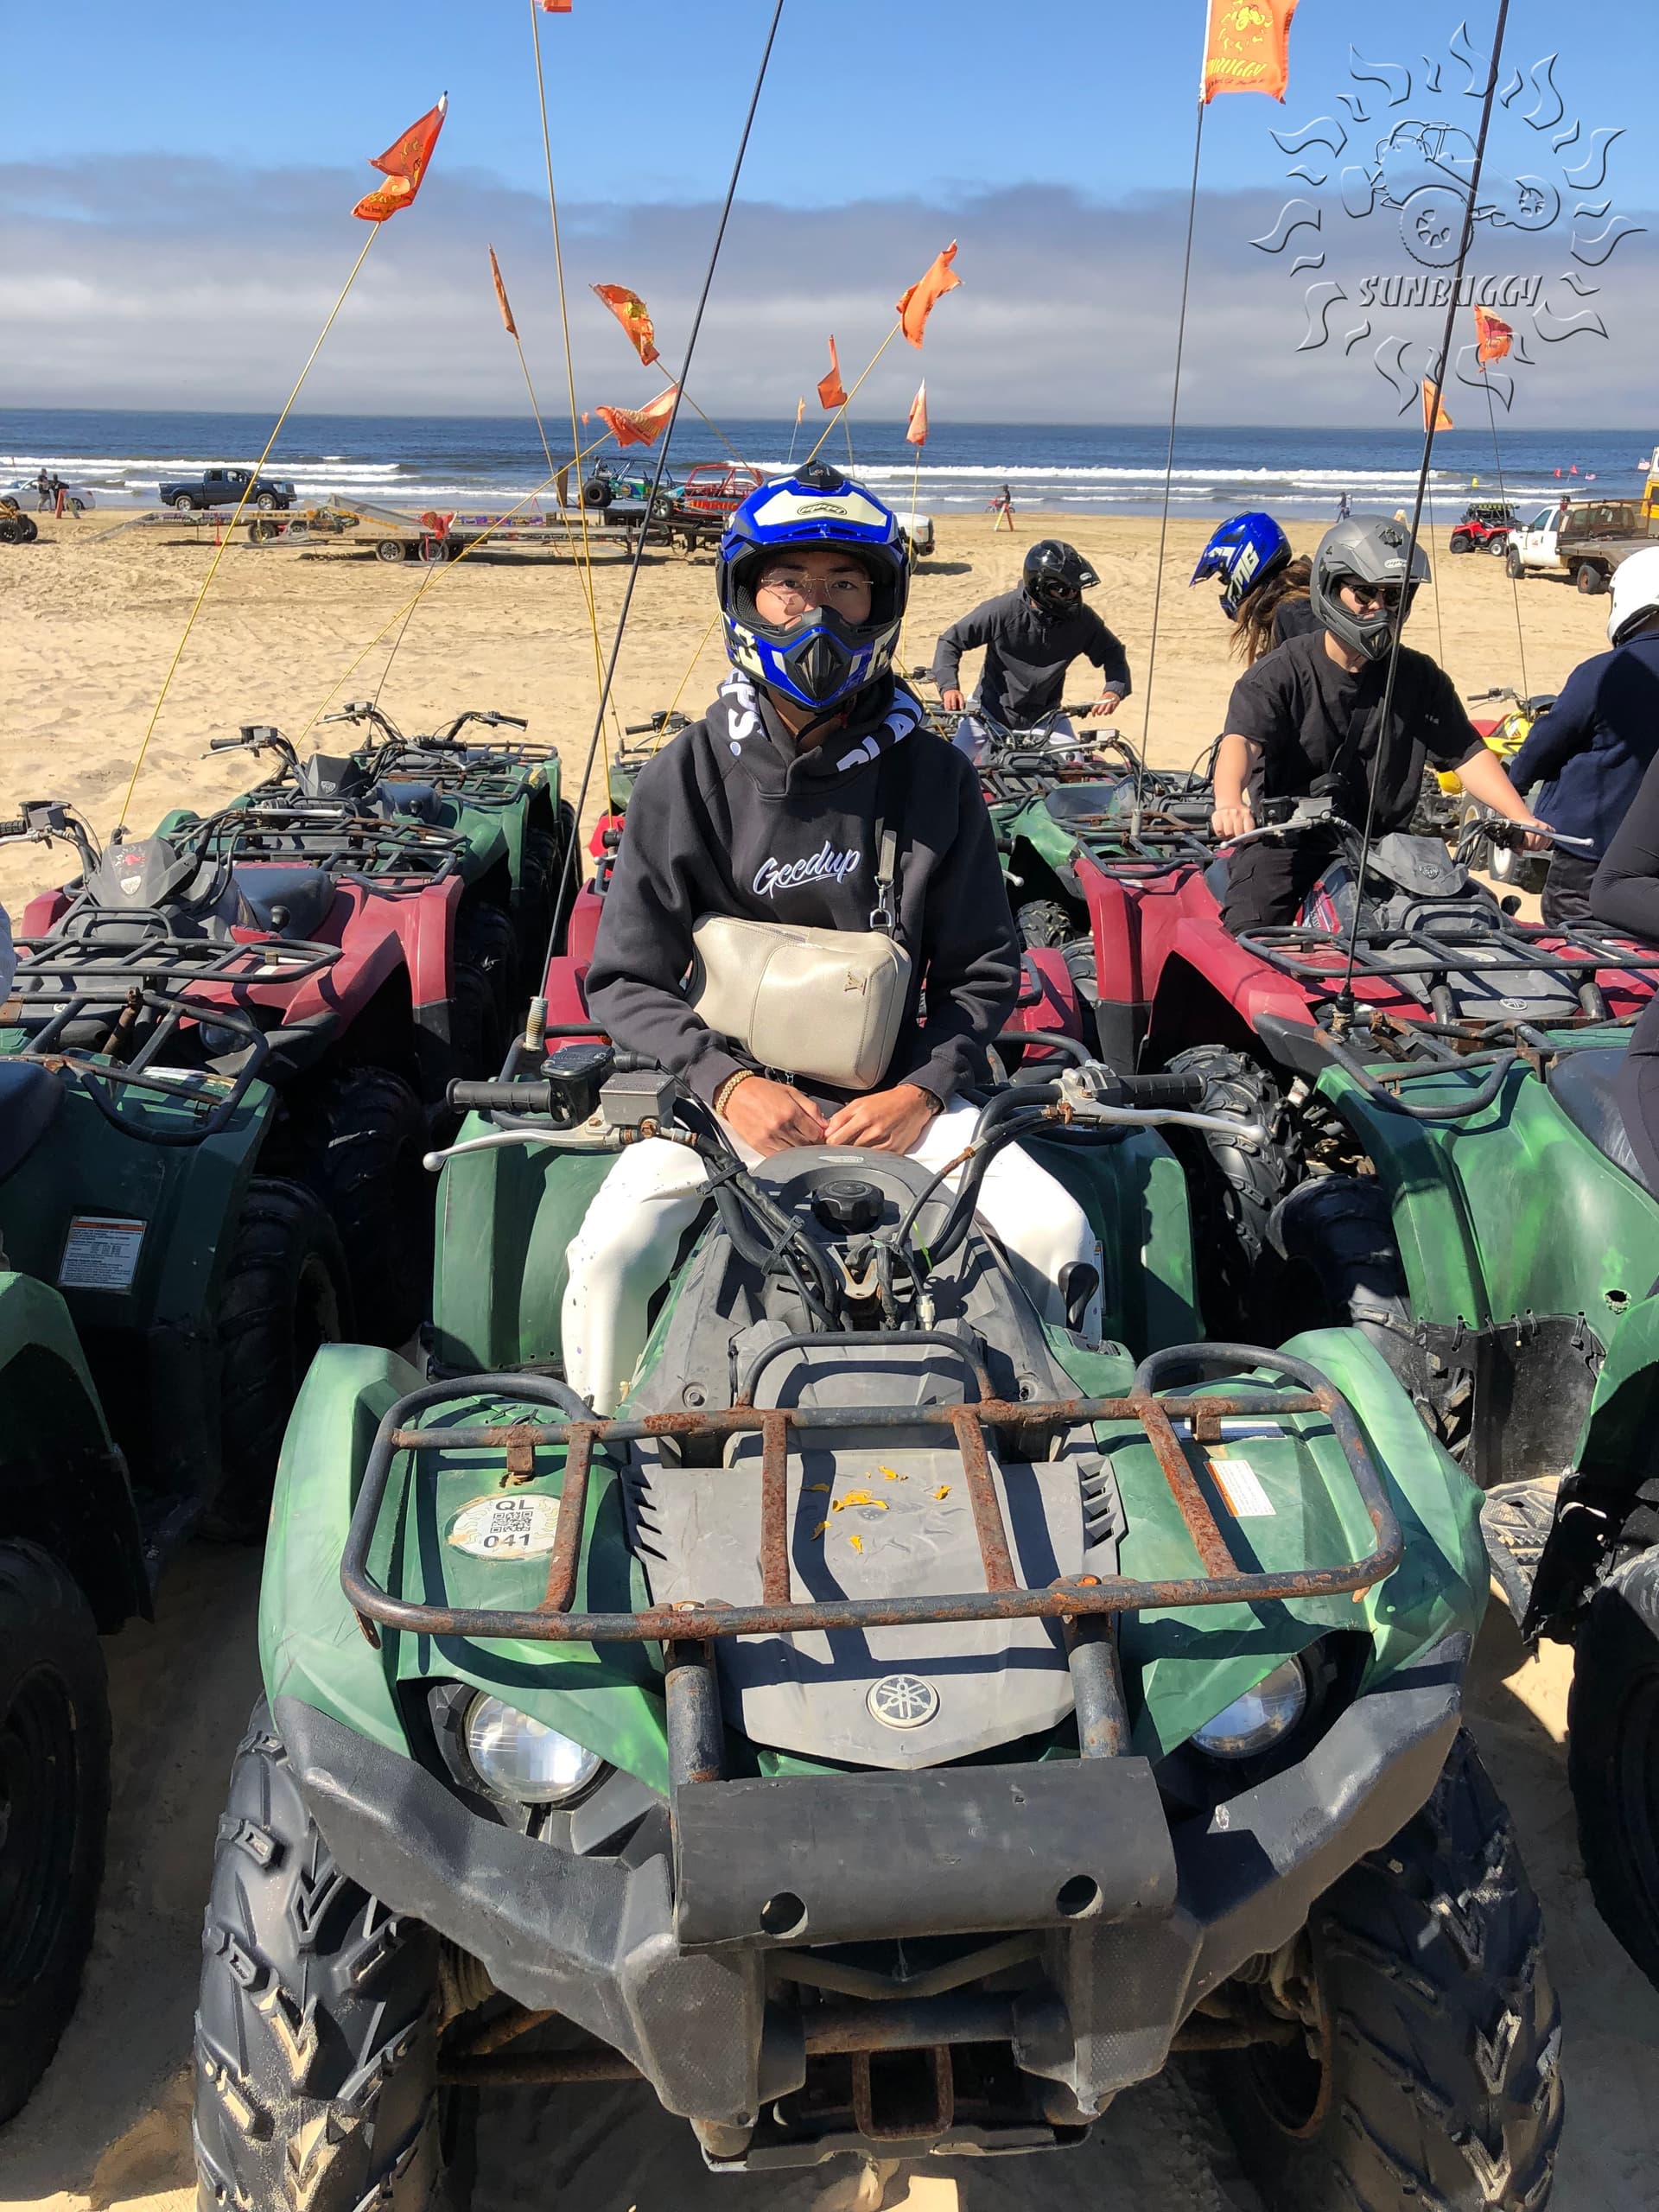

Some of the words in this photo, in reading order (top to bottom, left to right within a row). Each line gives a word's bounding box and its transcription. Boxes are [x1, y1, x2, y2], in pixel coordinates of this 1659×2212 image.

[753, 839, 861, 899] Geedup
[495, 1499, 535, 1511] QL
[483, 1533, 531, 1549] 041
